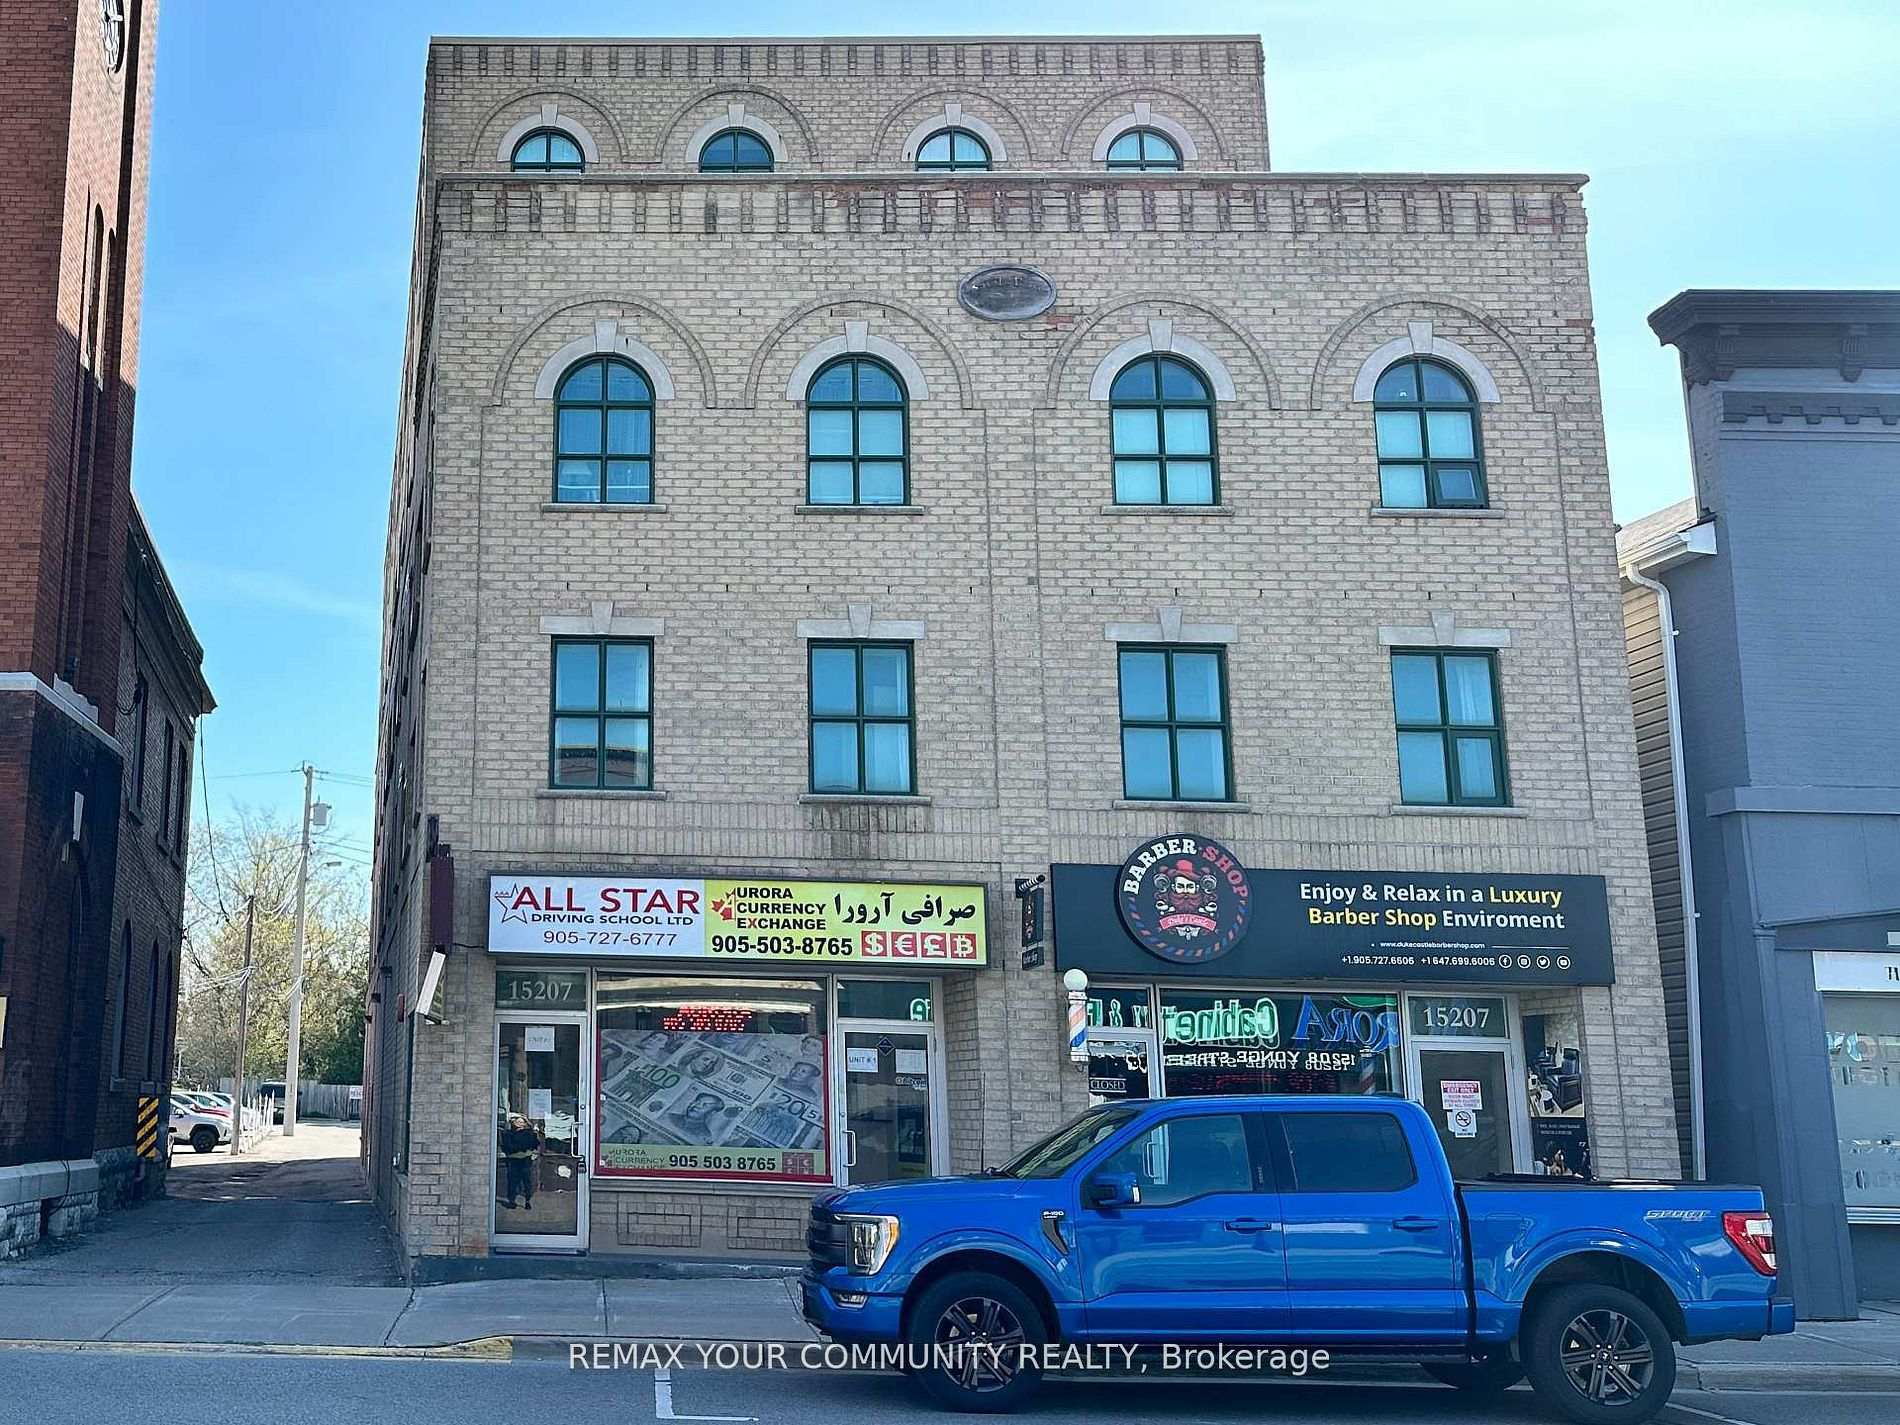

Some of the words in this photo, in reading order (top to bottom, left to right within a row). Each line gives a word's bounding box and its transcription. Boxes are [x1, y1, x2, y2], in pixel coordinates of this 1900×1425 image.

[1124, 838, 1197, 895] BARBER
[1202, 846, 1249, 897] SHOP
[511, 886, 586, 912] ALL
[600, 887, 700, 914] STAR
[1300, 883, 1356, 903] Enjoy
[1362, 885, 1377, 901] &
[1383, 885, 1440, 902] Relax
[1446, 886, 1466, 902] in
[1471, 889, 1483, 902] a
[1489, 887, 1562, 908] Luxury
[736, 902, 827, 915] CURRENCY
[833, 892, 894, 924] آرورا
[902, 893, 976, 926] صرافی
[531, 913, 595, 924] DRIVING
[600, 915, 662, 925] SCHOOL
[667, 916, 694, 926] LTD
[736, 917, 826, 930] EXCHANGE
[1309, 908, 1379, 925] Barber
[1385, 910, 1437, 930] Shop
[1443, 911, 1565, 928] Enviroment
[543, 930, 678, 946] 905-727-6777
[711, 935, 853, 956] 905-503-8765
[509, 980, 573, 1000] 15207
[1424, 1007, 1489, 1028] 15207
[1090, 1079, 1125, 1090] CLOSED
[669, 1154, 698, 1168] 905
[703, 1156, 731, 1169] 503
[737, 1157, 776, 1171] 8765
